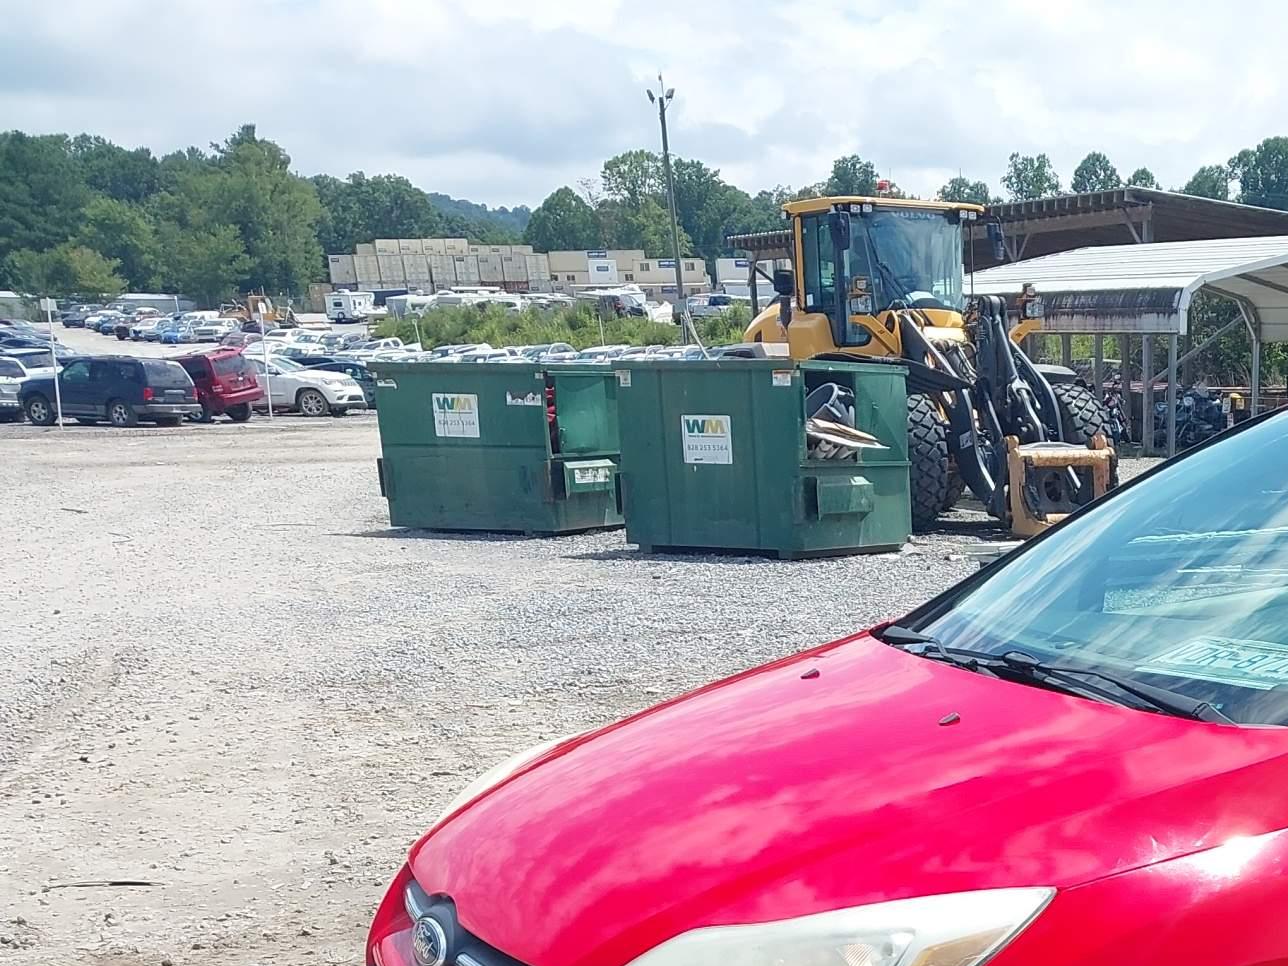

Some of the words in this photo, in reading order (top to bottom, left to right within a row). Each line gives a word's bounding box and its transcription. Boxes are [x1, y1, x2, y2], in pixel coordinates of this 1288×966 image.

[891, 211, 936, 220] VOLVO
[435, 396, 475, 410] WM
[685, 419, 727, 434] WM
